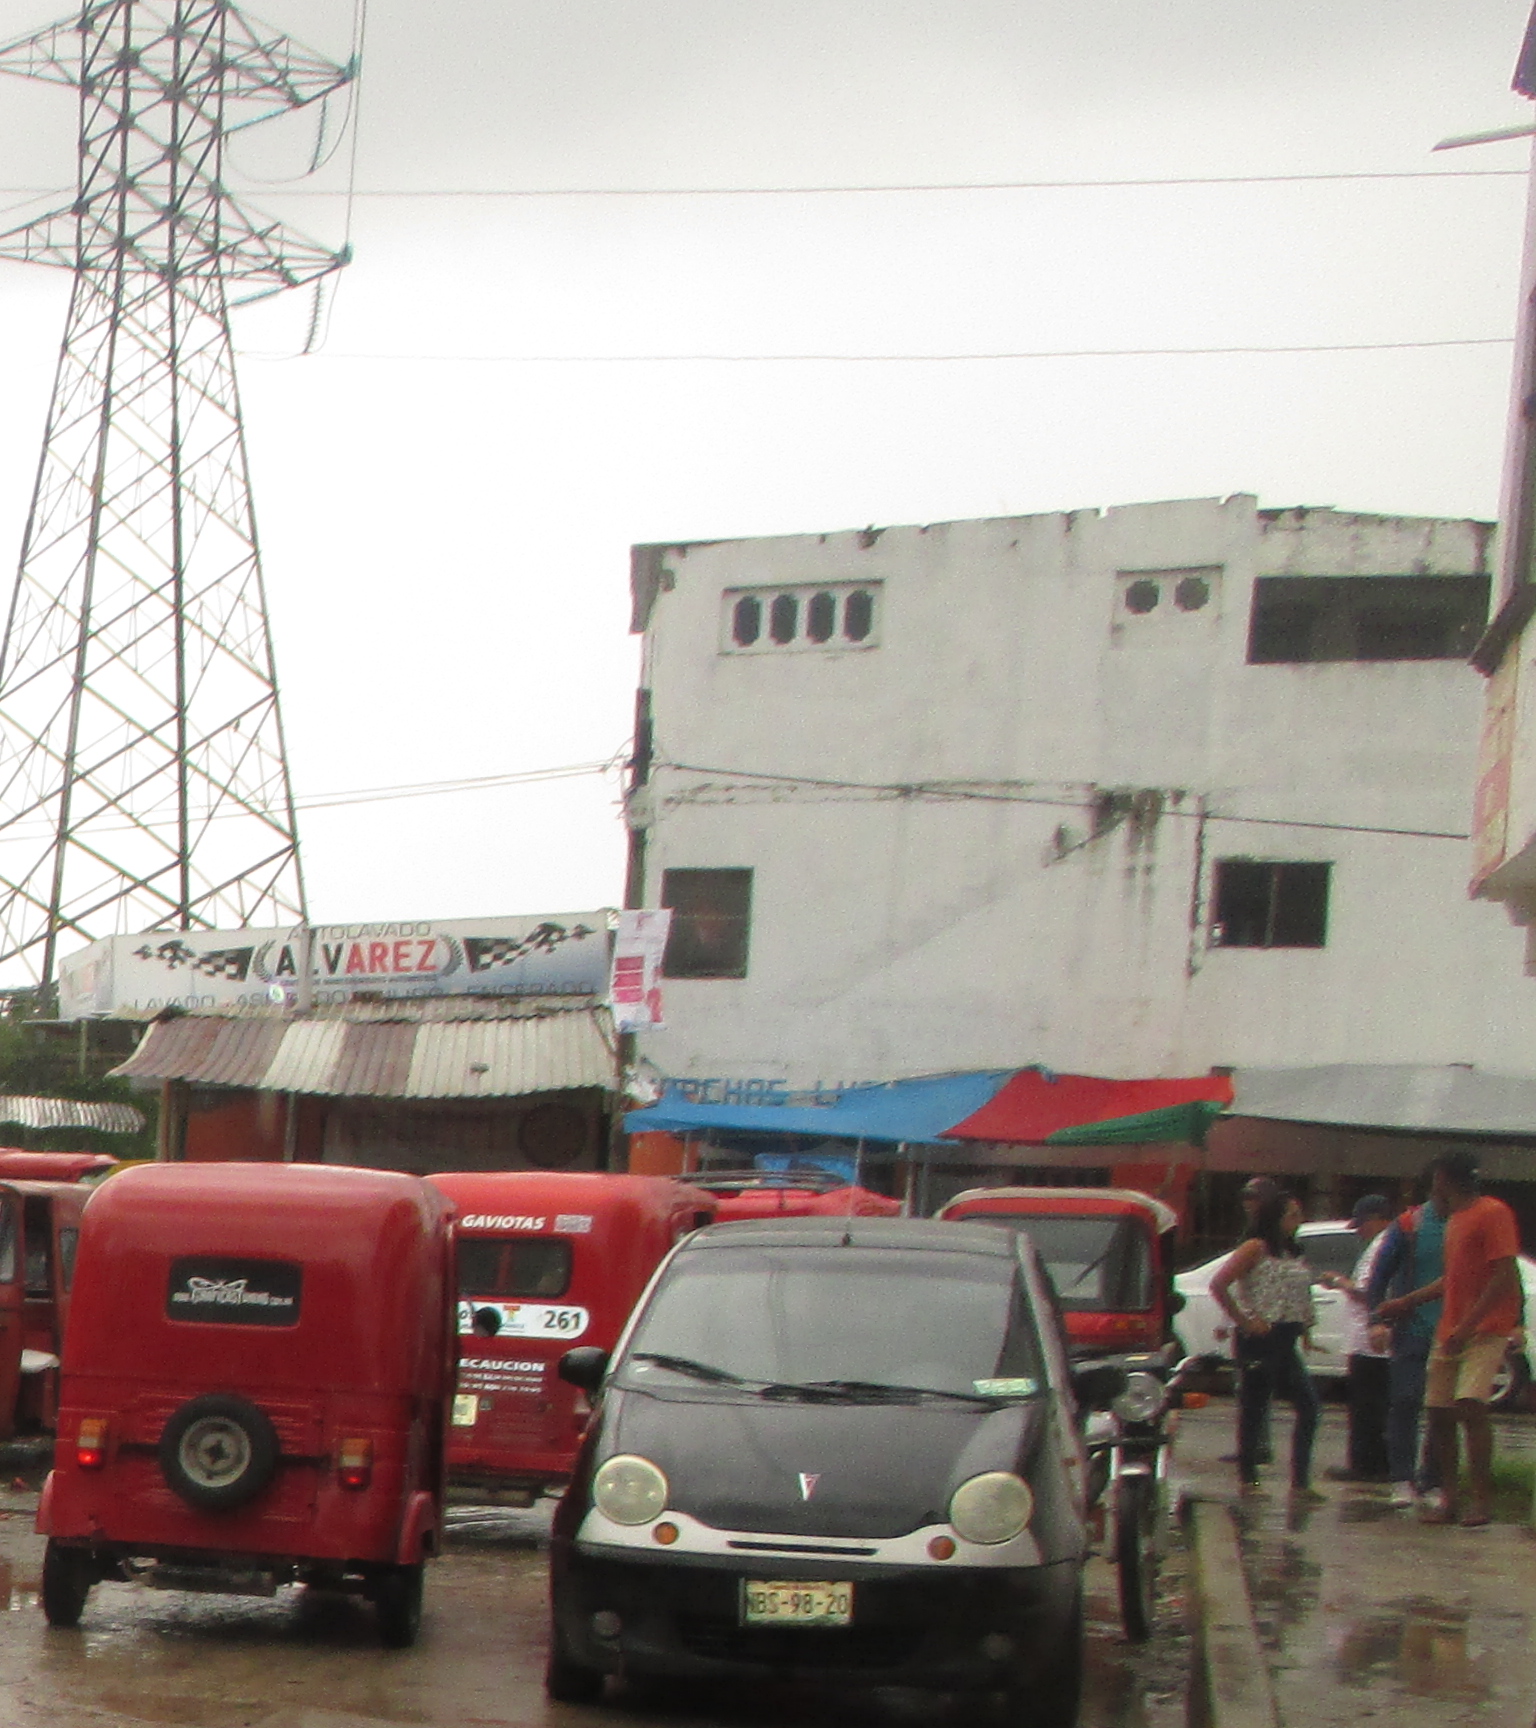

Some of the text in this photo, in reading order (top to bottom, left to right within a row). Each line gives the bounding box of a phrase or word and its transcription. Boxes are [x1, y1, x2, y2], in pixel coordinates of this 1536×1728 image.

[287, 922, 431, 940] ATOLAVADO
[275, 939, 437, 976] AVAREZ
[461, 1213, 547, 1232] GAVIOTAS
[543, 1309, 583, 1331] 261
[458, 1357, 546, 1372] ECAUCION
